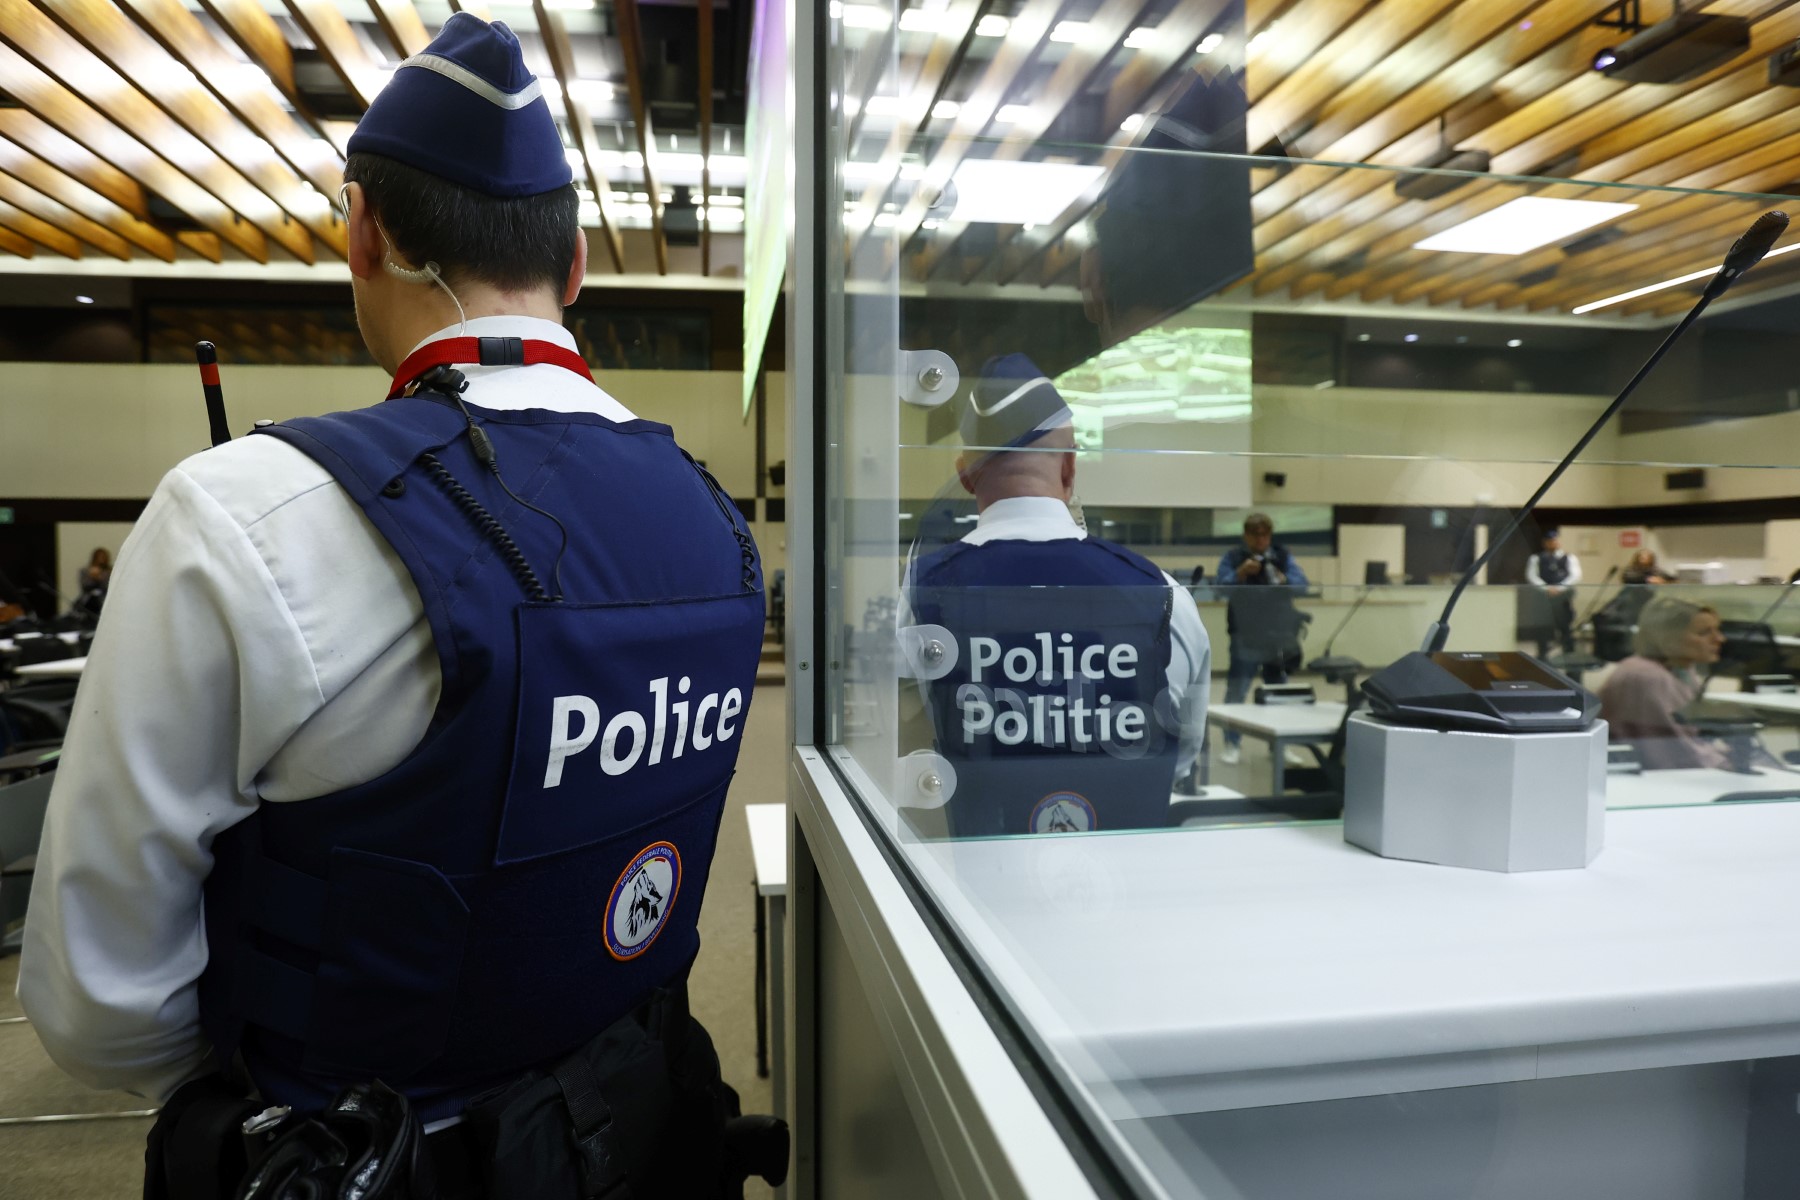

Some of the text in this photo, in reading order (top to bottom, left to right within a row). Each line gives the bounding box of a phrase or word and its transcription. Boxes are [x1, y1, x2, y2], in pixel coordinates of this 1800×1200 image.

[970, 632, 1139, 682] Police
[543, 676, 742, 789] Police
[963, 694, 1146, 745] Politie
[620, 865, 637, 887] POLICE
[636, 847, 660, 866] FEDERALE
